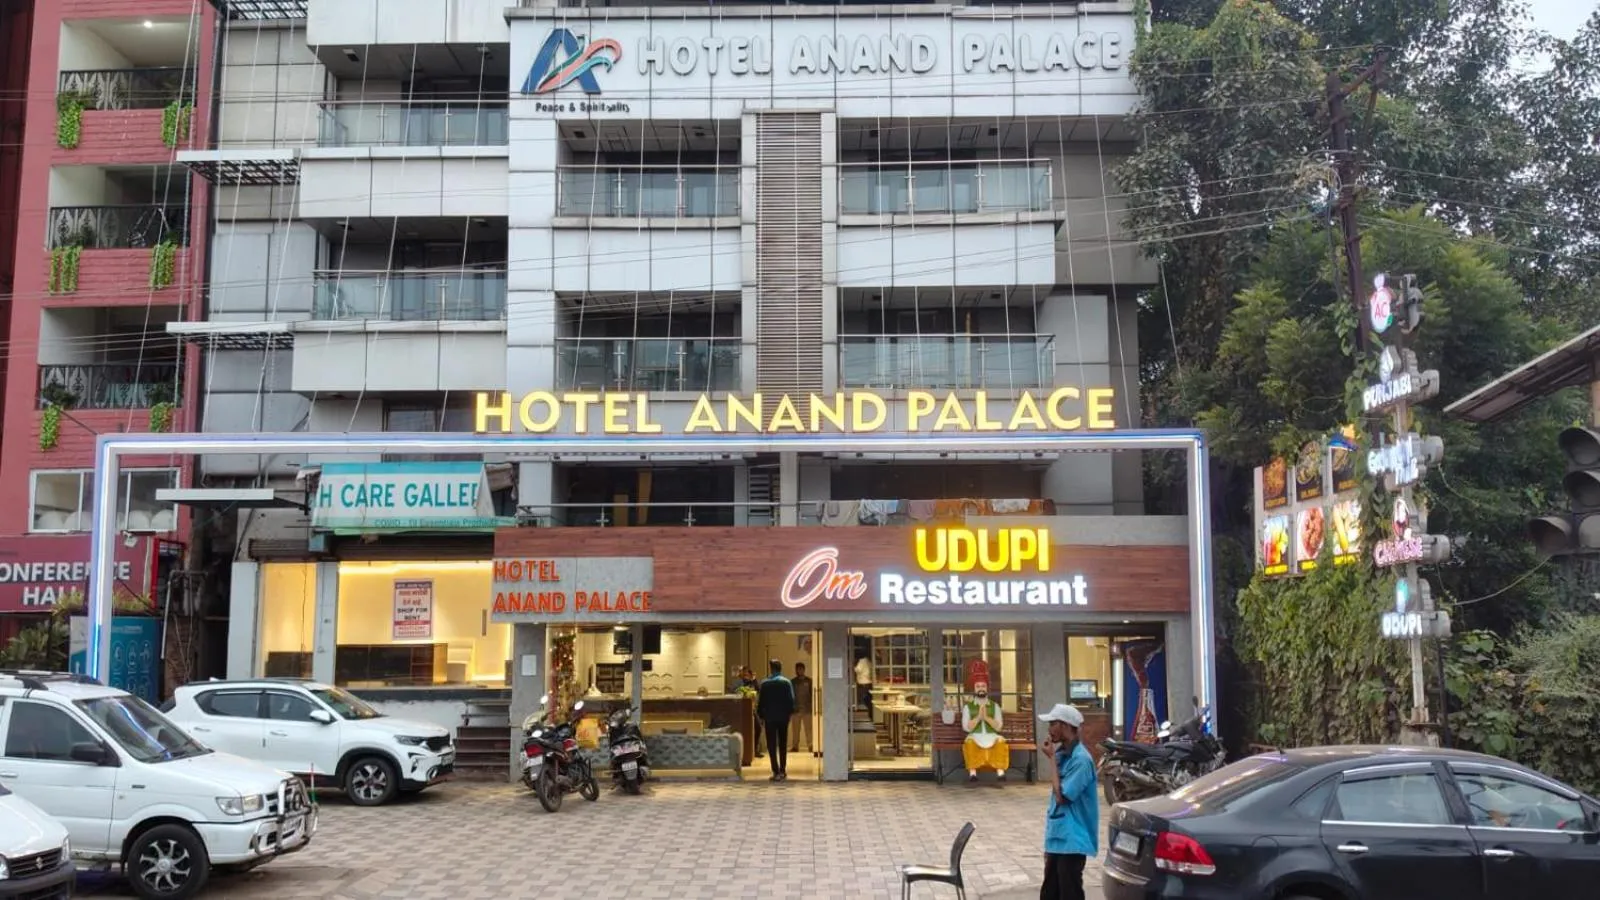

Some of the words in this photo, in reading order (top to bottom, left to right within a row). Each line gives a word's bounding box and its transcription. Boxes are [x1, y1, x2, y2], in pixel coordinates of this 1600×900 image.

[637, 33, 773, 76] HOTEL
[789, 33, 938, 75] ANAND
[963, 31, 1122, 72] PALACE
[535, 102, 565, 112] Peace
[568, 102, 576, 112] &
[474, 391, 662, 434] HOTEL
[685, 390, 888, 433] ANAND
[907, 387, 1116, 431] PALACE
[340, 483, 396, 508] CARE
[915, 528, 1050, 572] UDUPI
[493, 560, 561, 583] HOTEL
[781, 547, 867, 608] Om
[492, 592, 567, 614] ANAND
[574, 591, 652, 612] PALACE
[880, 573, 1088, 605] Restaurant
